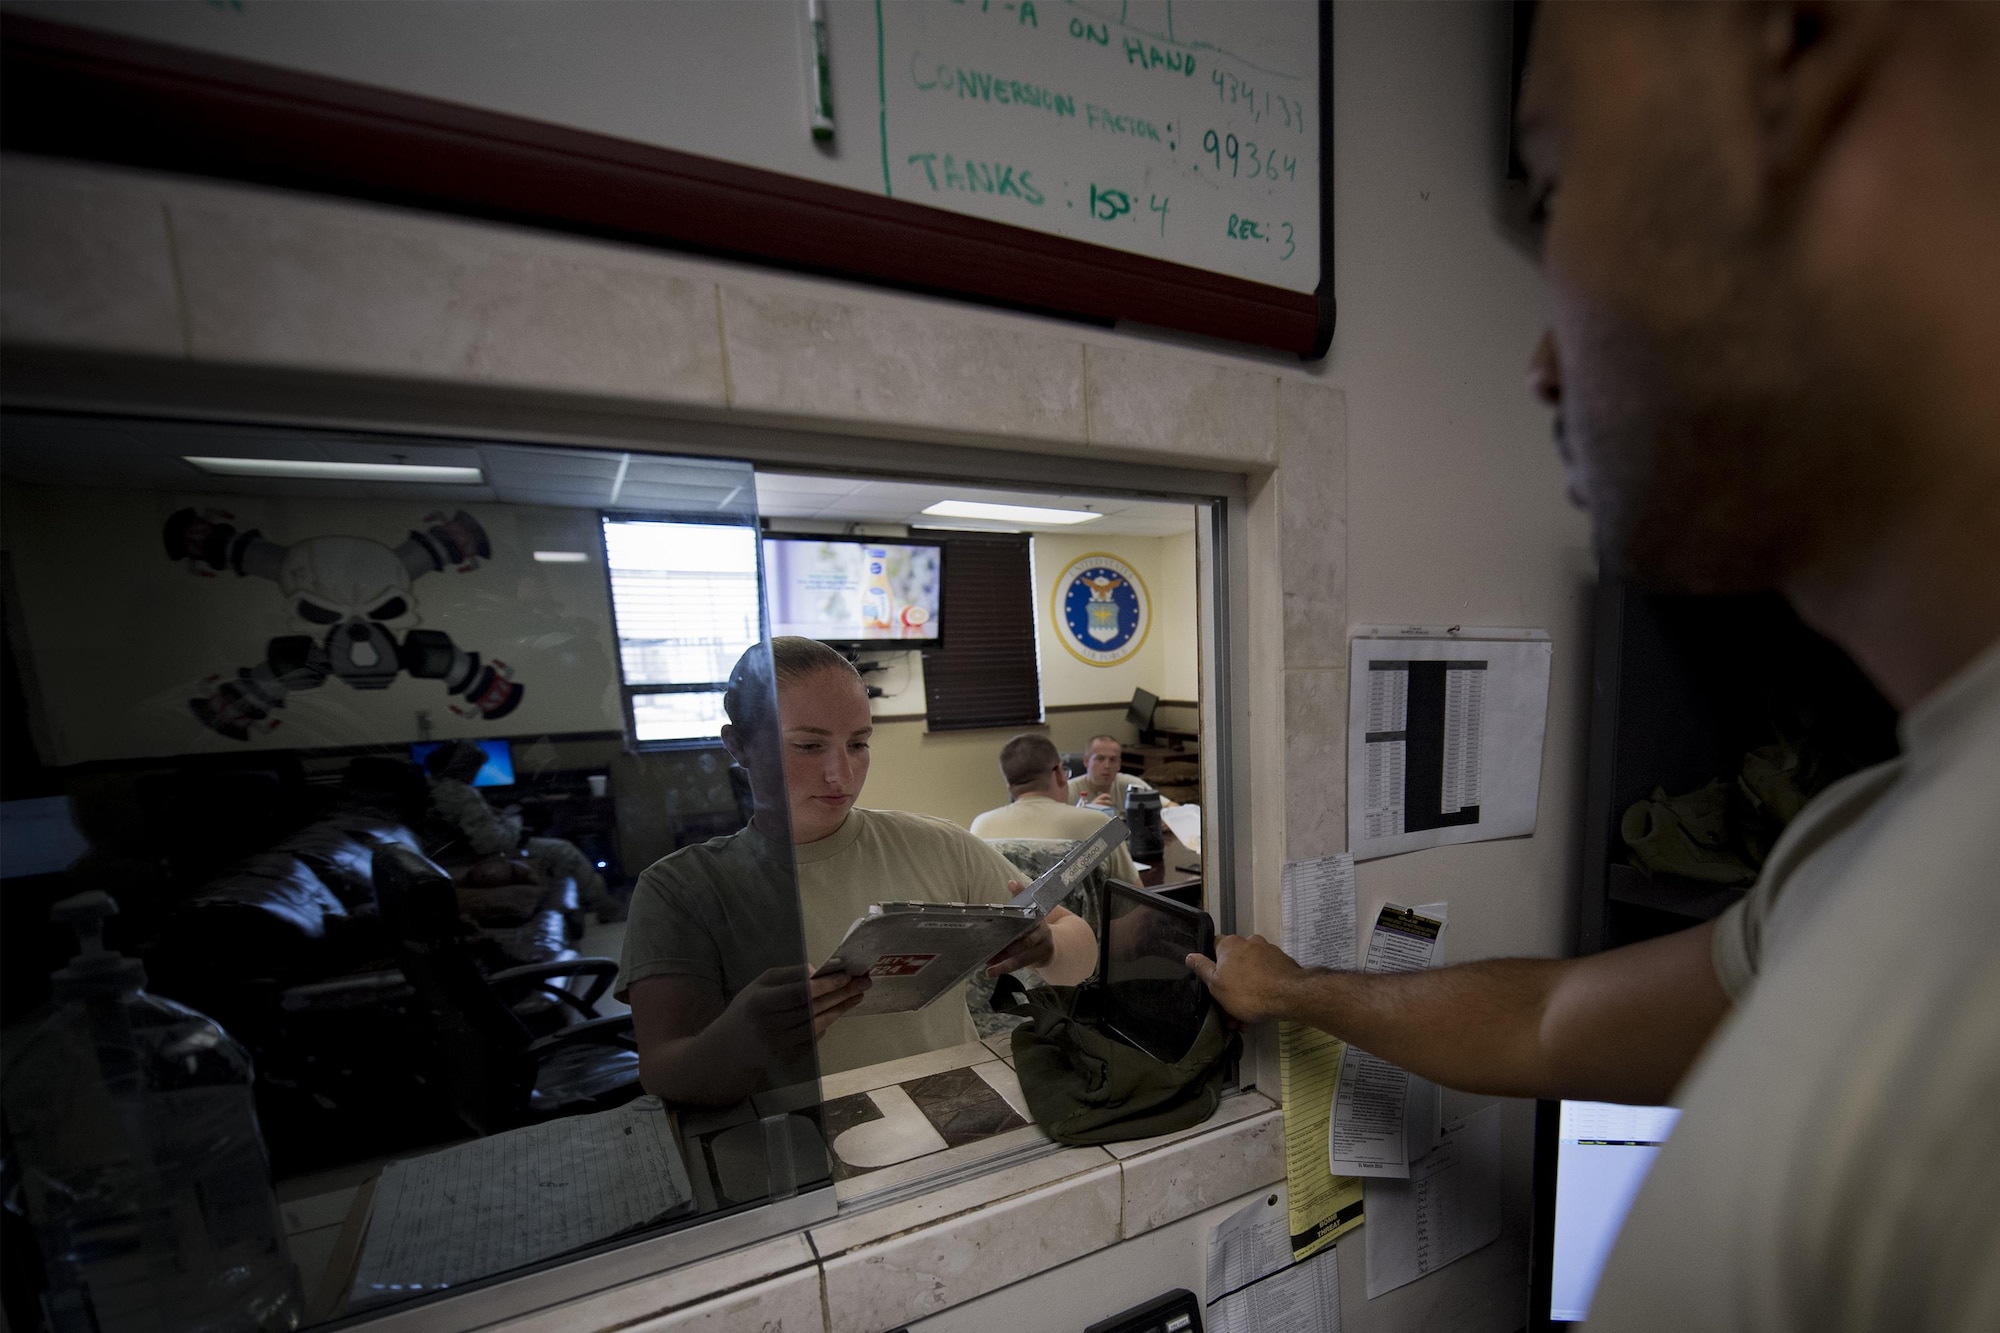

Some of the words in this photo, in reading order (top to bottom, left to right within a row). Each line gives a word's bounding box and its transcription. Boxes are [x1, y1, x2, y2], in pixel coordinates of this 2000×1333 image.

[1070, 17, 1109, 46] ON
[1122, 38, 1197, 76] HAND
[911, 51, 1076, 119] CONVERSION
[1150, 194, 1171, 237] 4
[1280, 222, 1296, 261] 3
[1317, 1219, 1341, 1237] THREAT
[1319, 1213, 1338, 1228] BOMB
